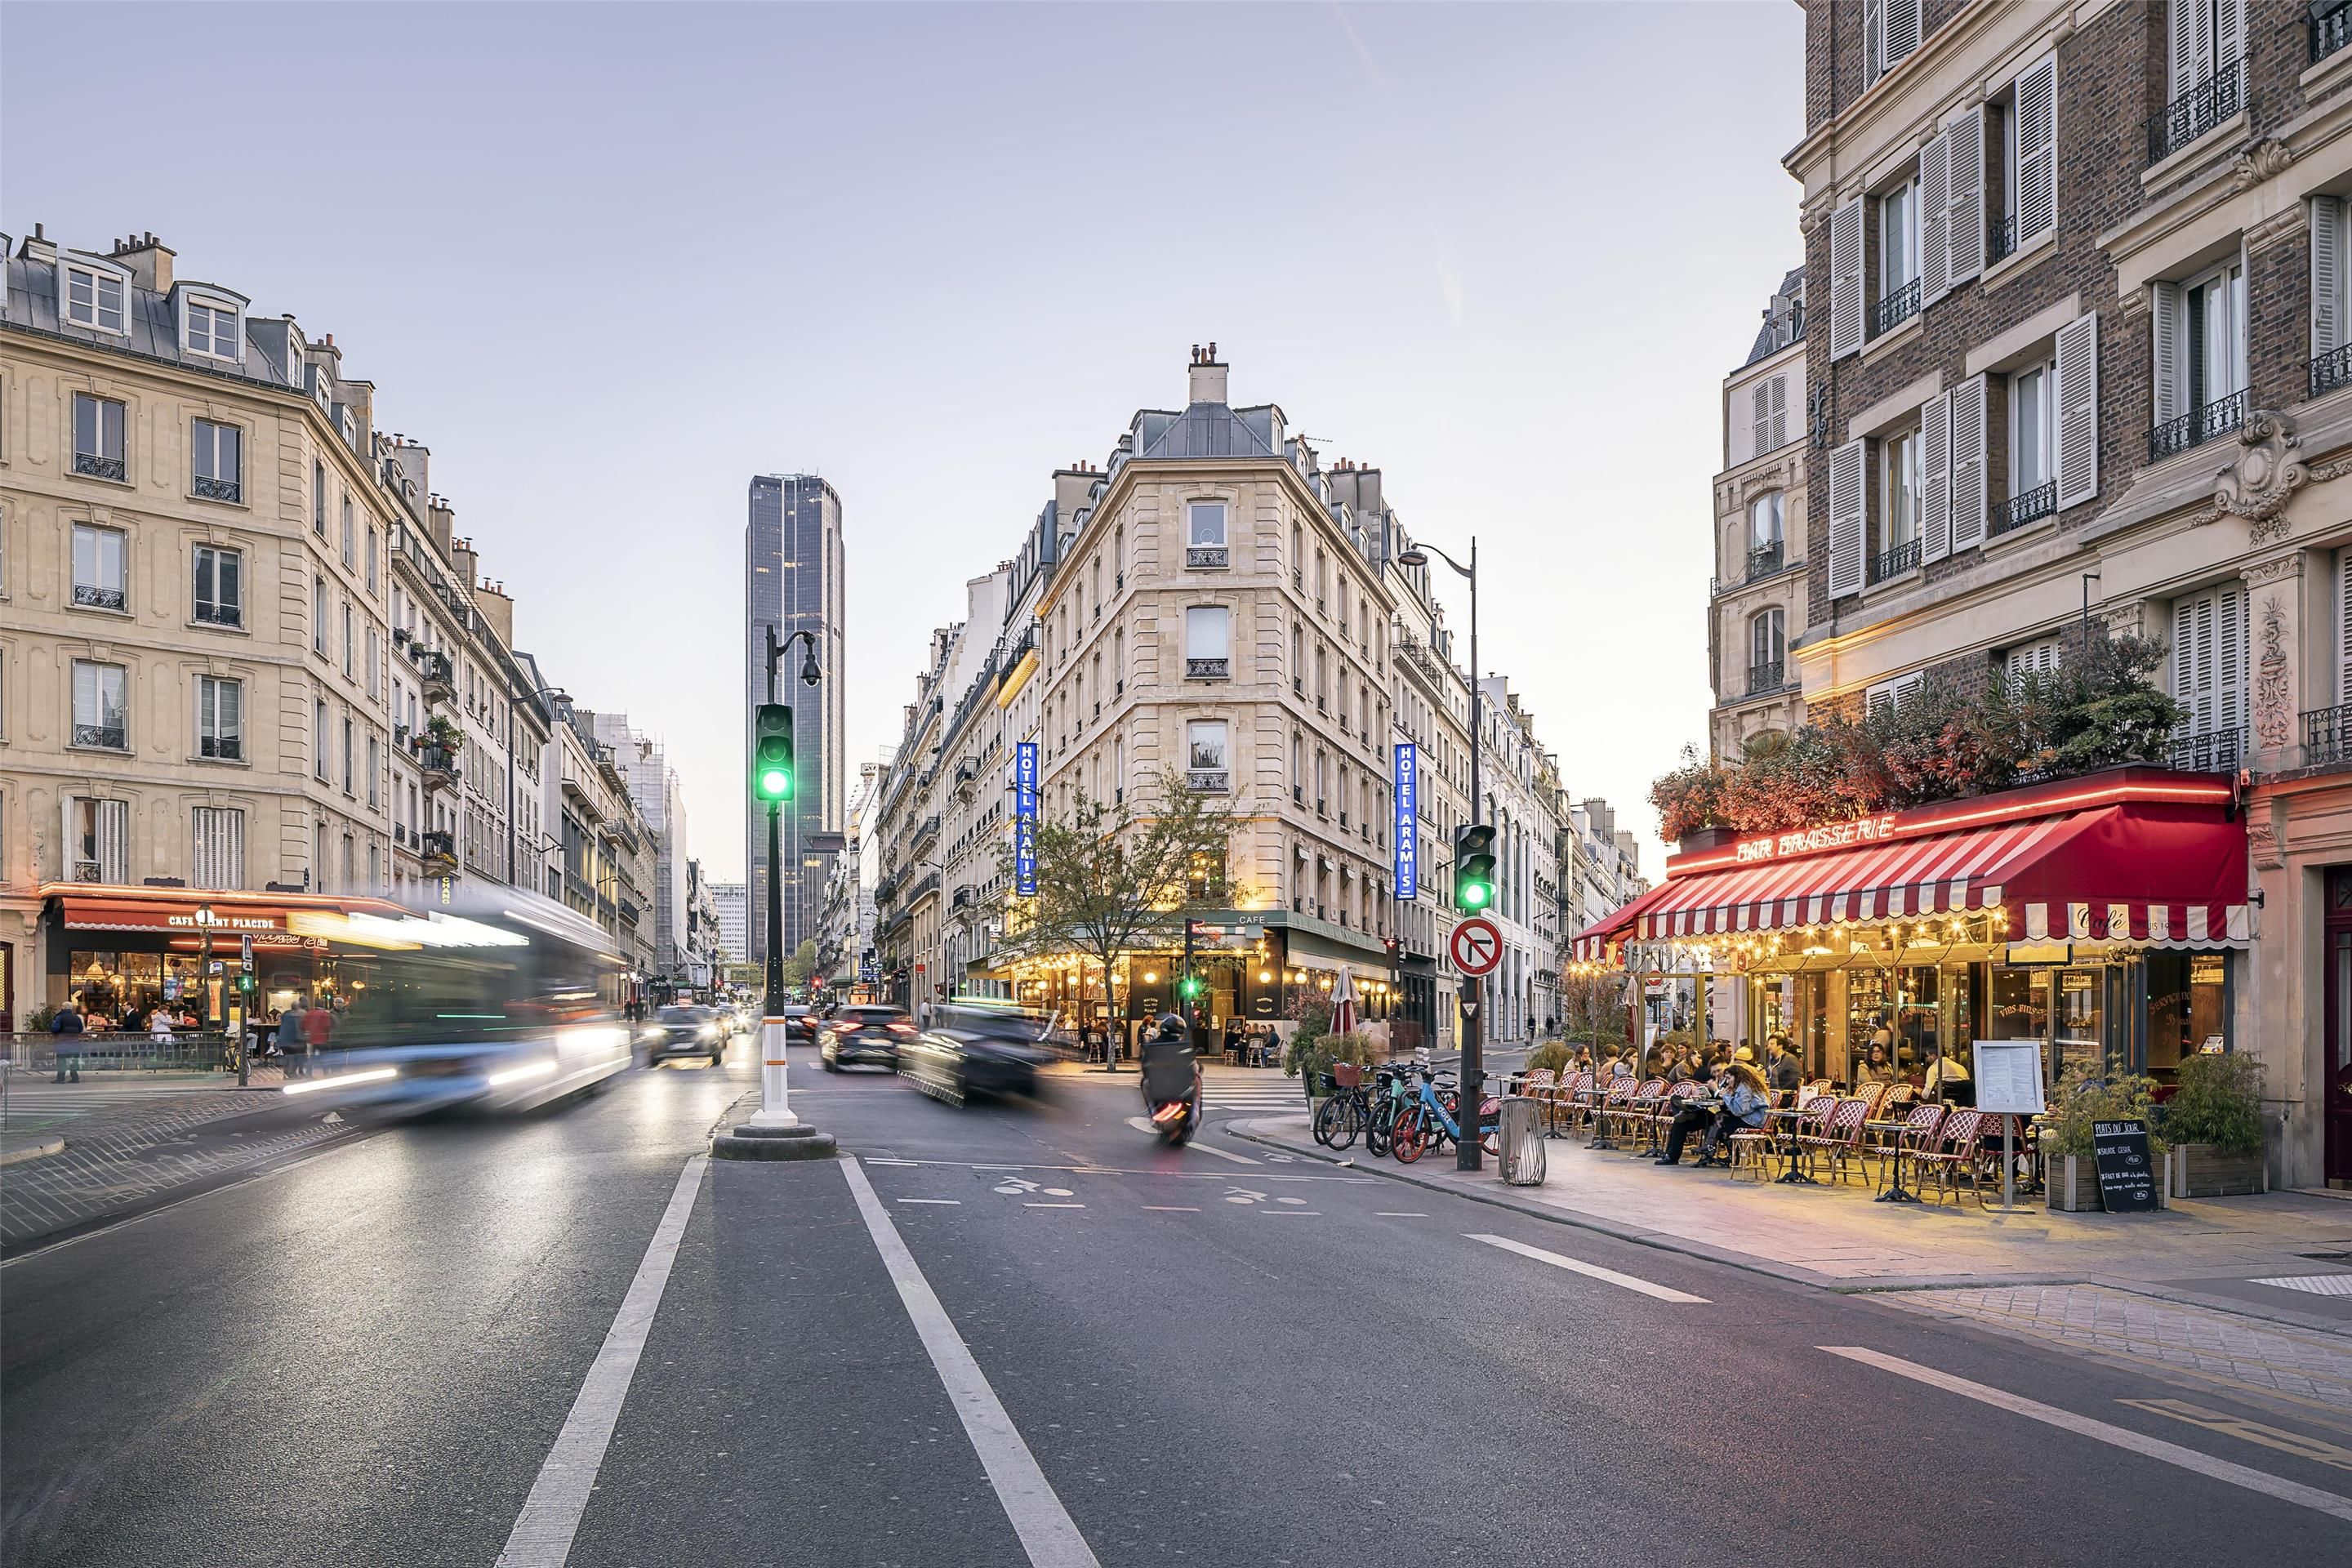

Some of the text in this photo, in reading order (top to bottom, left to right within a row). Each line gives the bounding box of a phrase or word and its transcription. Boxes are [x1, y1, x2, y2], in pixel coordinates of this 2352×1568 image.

[1021, 746, 1033, 807] HOTEL
[1400, 747, 1412, 808] HOTEL
[1020, 812, 1034, 884] ARAMIS
[1399, 813, 1414, 888] ARAMIS
[1736, 815, 1895, 863] BAR BRASSERIE
[442, 876, 450, 905] CHANG
[168, 915, 274, 929] CAFE INT PLACIDE
[1239, 915, 1266, 924] CAFE
[2077, 907, 2126, 938] Café
[1437, 1106, 1451, 1125] dott
[2095, 1122, 2140, 1134] PLATS DU JOUR
